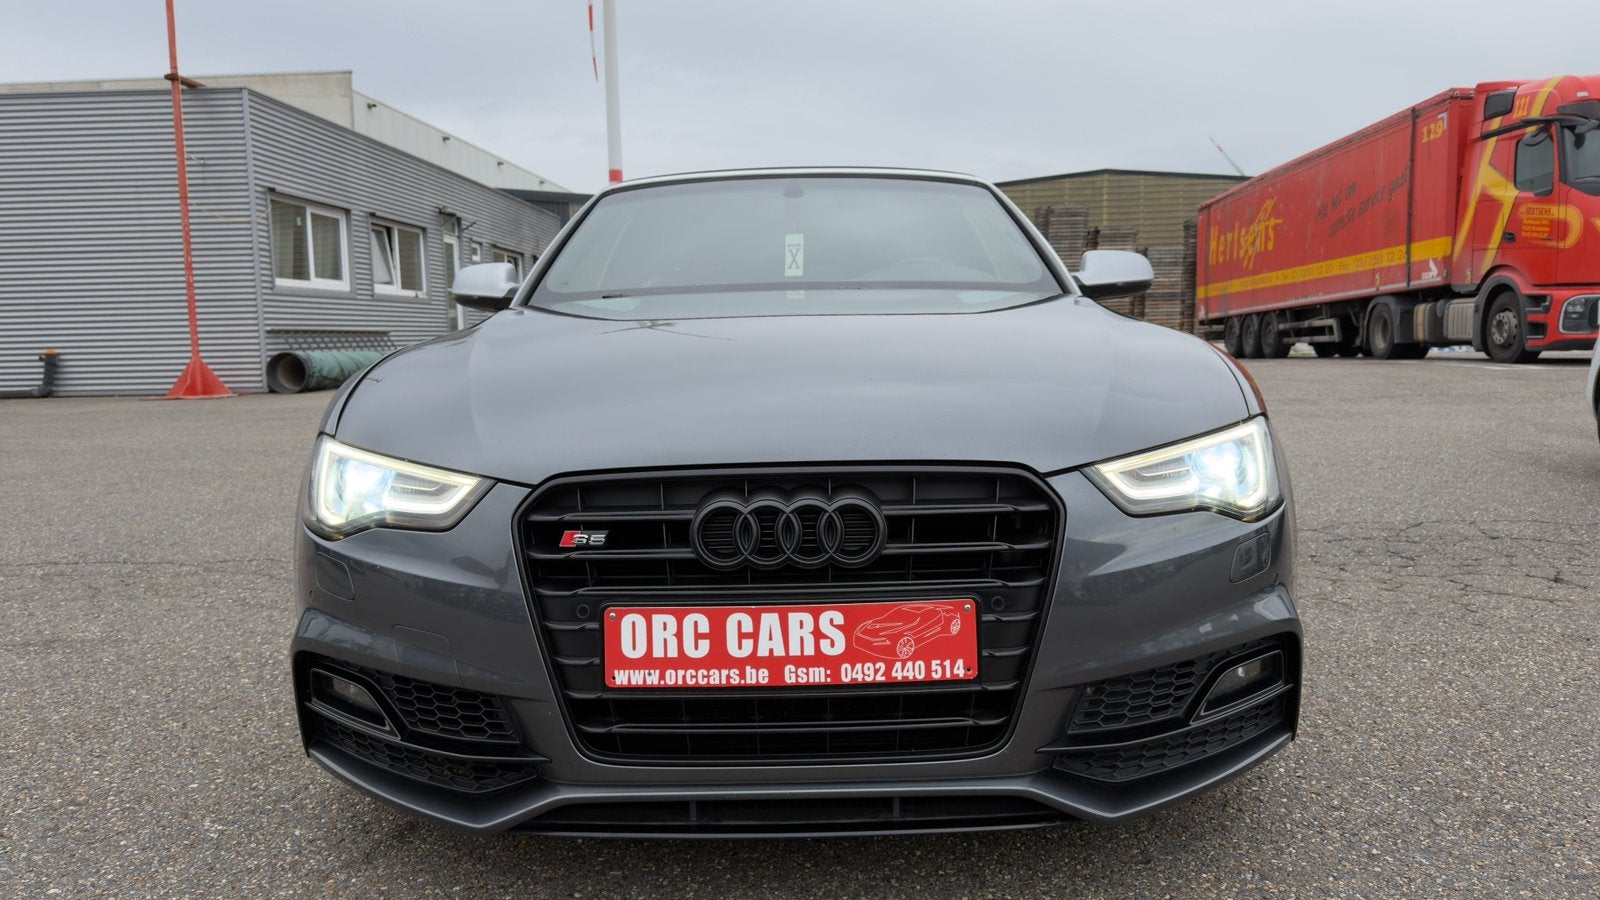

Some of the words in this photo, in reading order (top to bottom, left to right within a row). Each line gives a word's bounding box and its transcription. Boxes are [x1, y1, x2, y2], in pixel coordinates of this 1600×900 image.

[1512, 96, 1531, 118] 121
[1421, 120, 1444, 144] 129
[571, 534, 606, 545] S5
[620, 613, 710, 659] ORC
[726, 610, 846, 658] CARS
[614, 666, 769, 685] www.orccars.be
[784, 664, 831, 684] Gsm:
[841, 662, 885, 682] 0492
[891, 660, 926, 680] 440
[931, 658, 965, 679] 514
